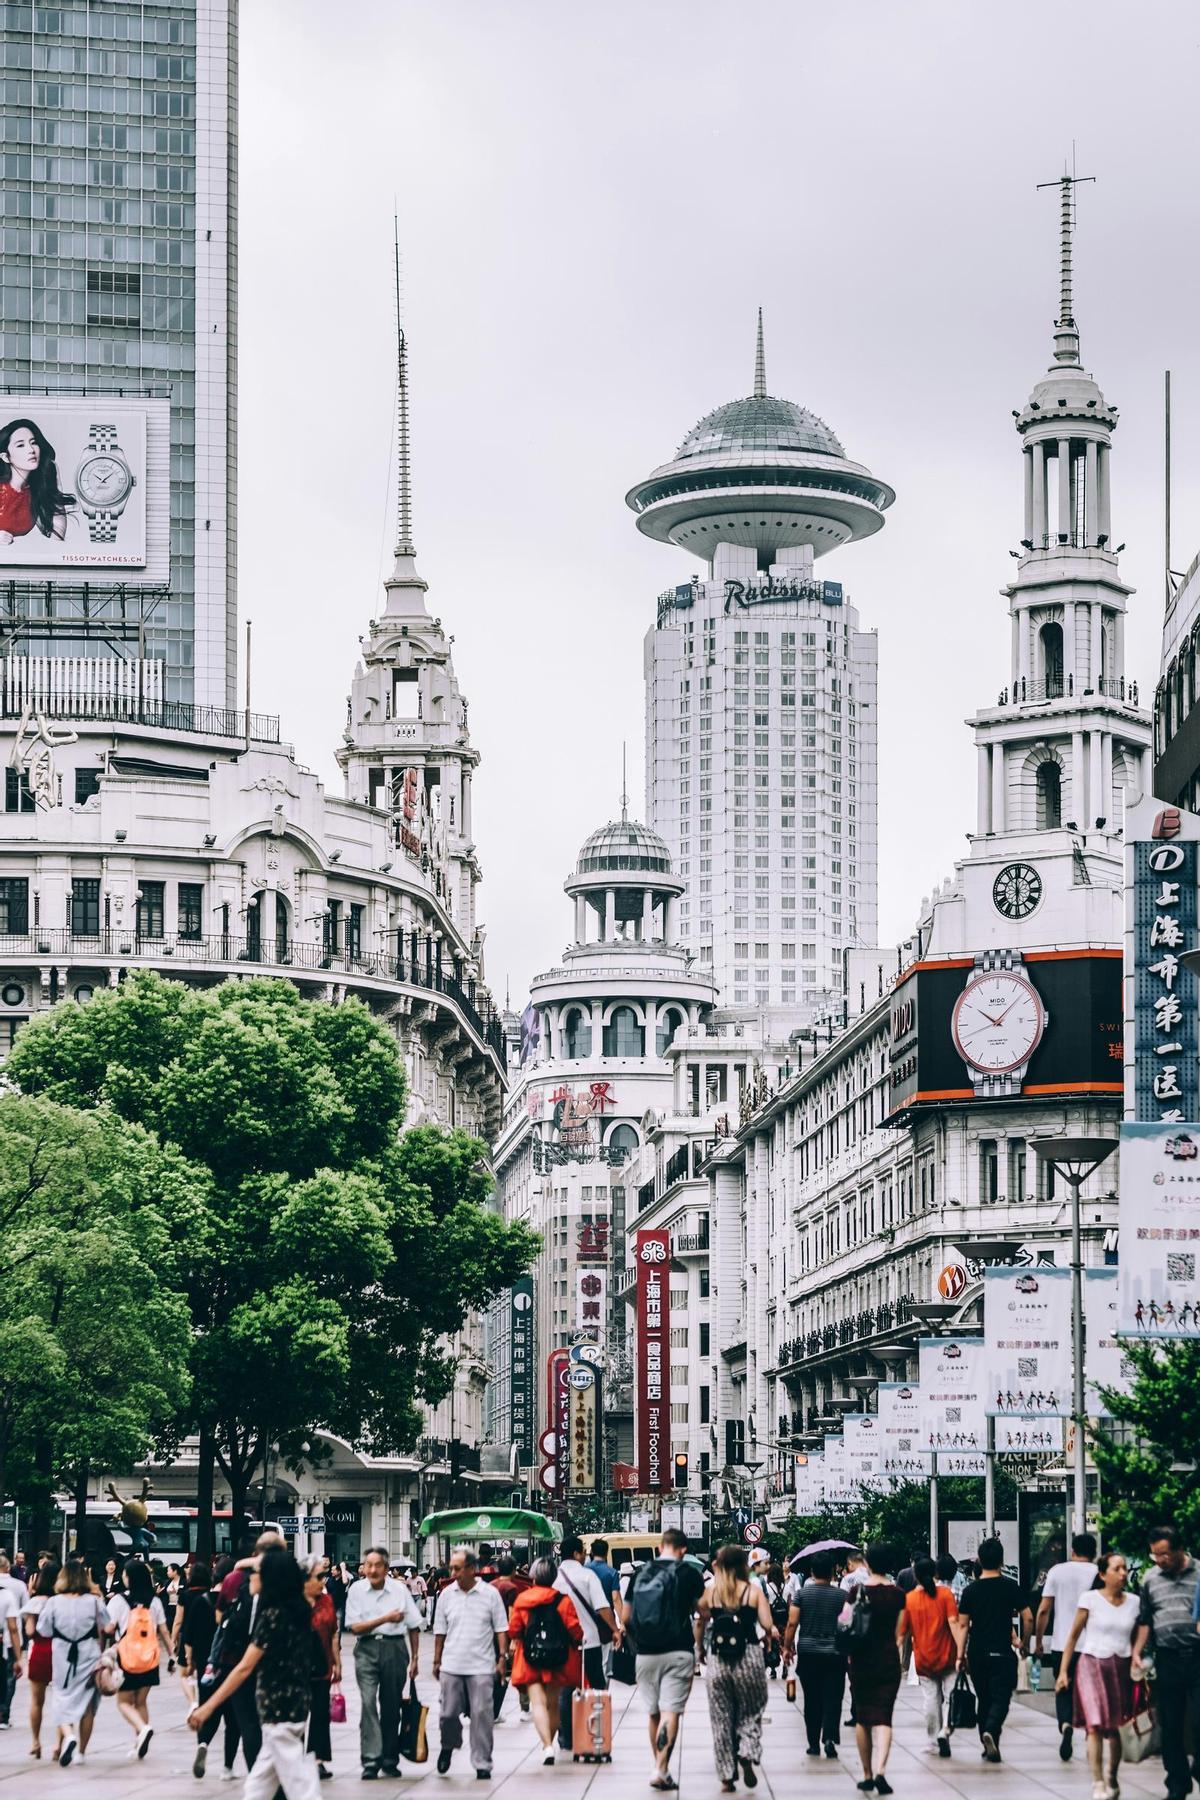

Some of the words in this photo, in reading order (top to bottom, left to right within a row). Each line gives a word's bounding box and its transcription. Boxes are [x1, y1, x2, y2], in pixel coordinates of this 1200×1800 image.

[62, 555, 142, 563] TISSOTWATCHES.CN
[676, 593, 691, 601] BLU
[724, 573, 821, 615] Radisson
[825, 589, 842, 599] BLU
[646, 1269, 662, 1400] 上海市第一食品商店
[513, 1317, 525, 1450] 上海市第一百货商店
[649, 1407, 660, 1431] First
[649, 1433, 661, 1485] Foodhall
